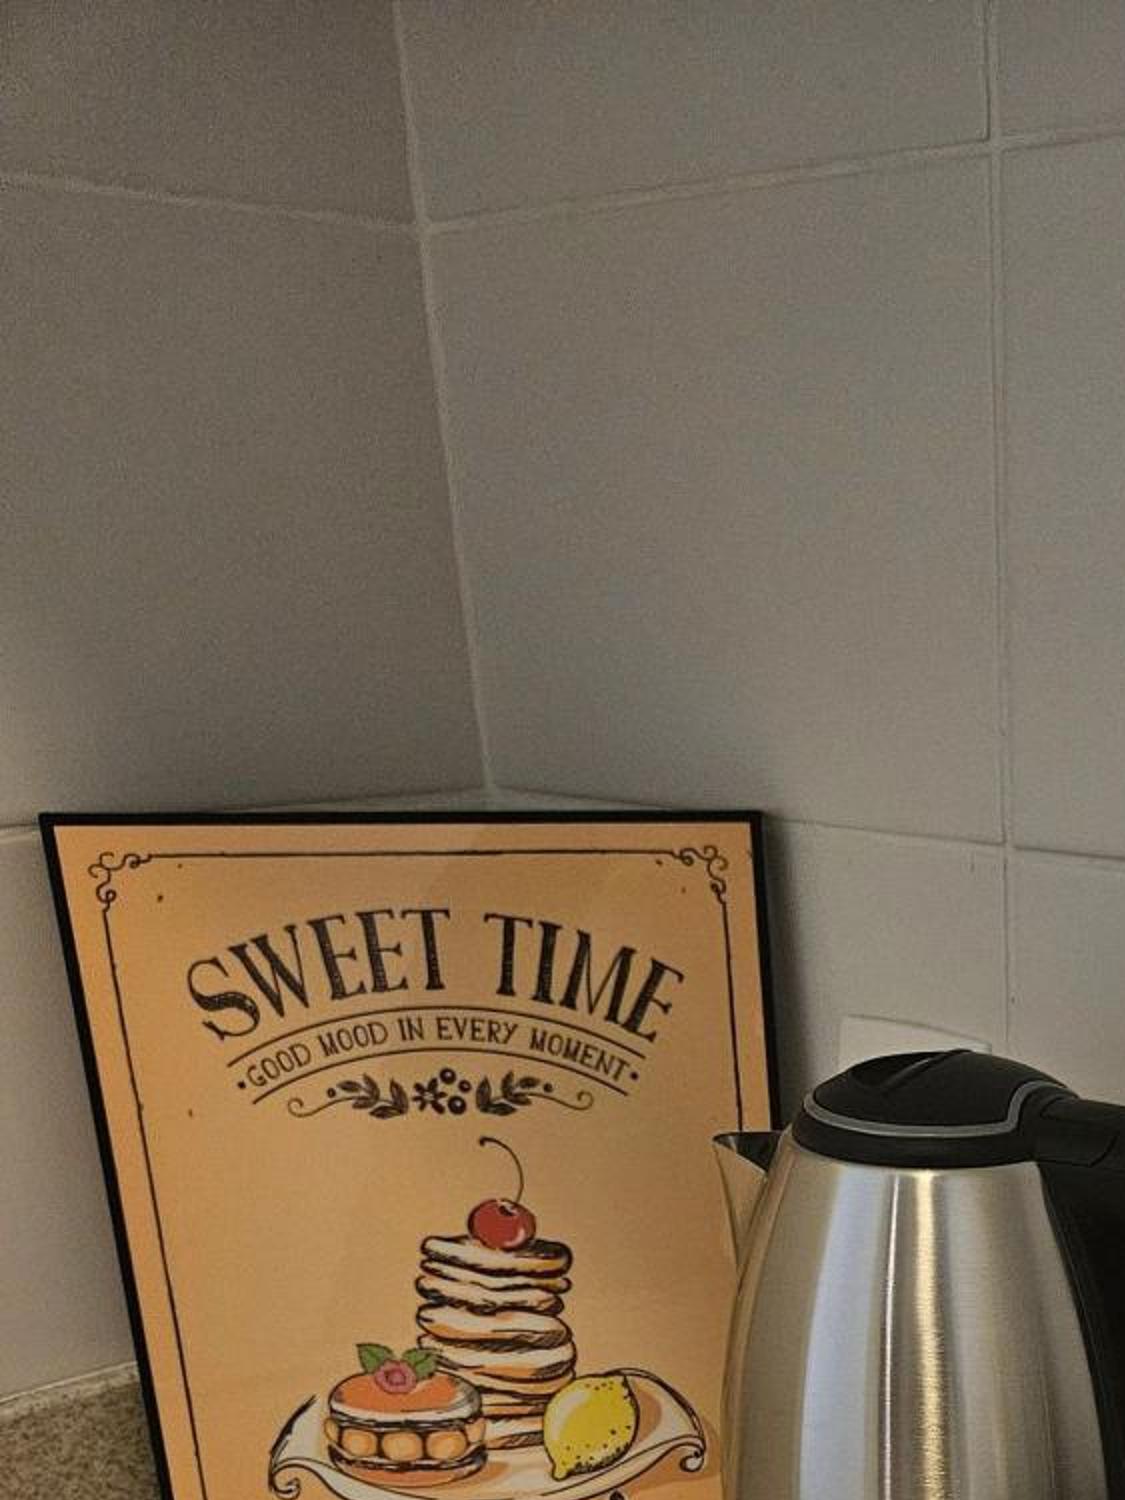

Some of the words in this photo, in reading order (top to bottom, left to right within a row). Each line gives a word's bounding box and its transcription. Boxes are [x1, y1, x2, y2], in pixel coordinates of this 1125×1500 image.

[187, 908, 451, 1042] SWEET
[484, 912, 685, 1042] TIME
[246, 1043, 312, 1087] GOOD
[318, 1021, 389, 1058] MOOD
[397, 1017, 425, 1041] IN
[437, 1017, 519, 1045] EVERY
[528, 1027, 632, 1080] MOMENT
